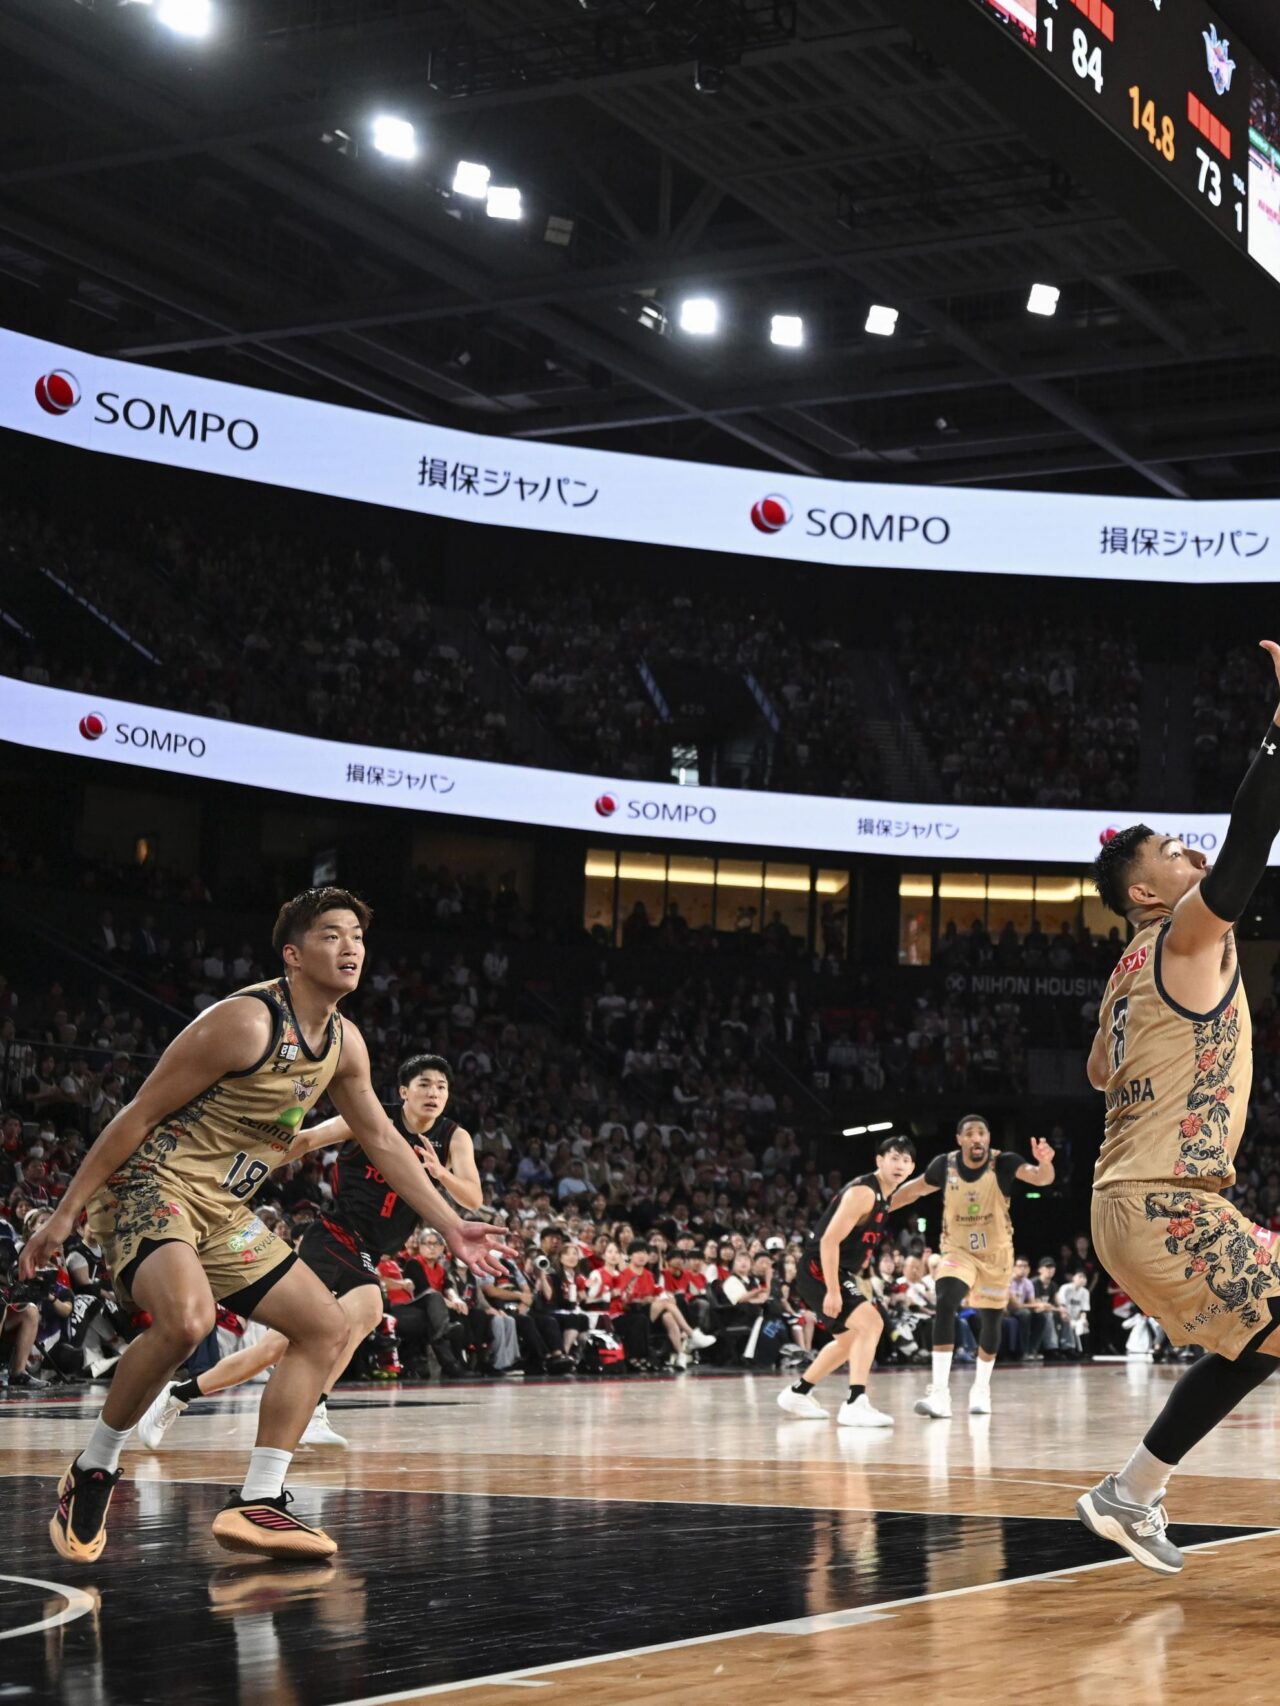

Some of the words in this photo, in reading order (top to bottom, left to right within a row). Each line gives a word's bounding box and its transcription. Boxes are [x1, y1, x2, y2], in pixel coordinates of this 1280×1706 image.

[1043, 17, 1054, 52] 1
[1072, 27, 1104, 94] 84
[1128, 85, 1176, 162] 14.8
[1195, 146, 1222, 207] 73
[1234, 201, 1243, 233] 1
[93, 391, 260, 451] SOMPO
[417, 455, 600, 508] 損保ジャパン
[805, 507, 951, 545] SOMPO
[1099, 525, 1270, 559] 損保ジャパン
[114, 721, 207, 757] SOMPO
[345, 762, 456, 795] 損保ジャパン
[627, 800, 717, 825] SOMPO
[857, 817, 960, 840] 損保ジャパン
[971, 974, 1028, 996] NIHON
[1035, 975, 1106, 997] HOUSIN
[220, 1150, 270, 1200] 18
[969, 1232, 988, 1250] 21
